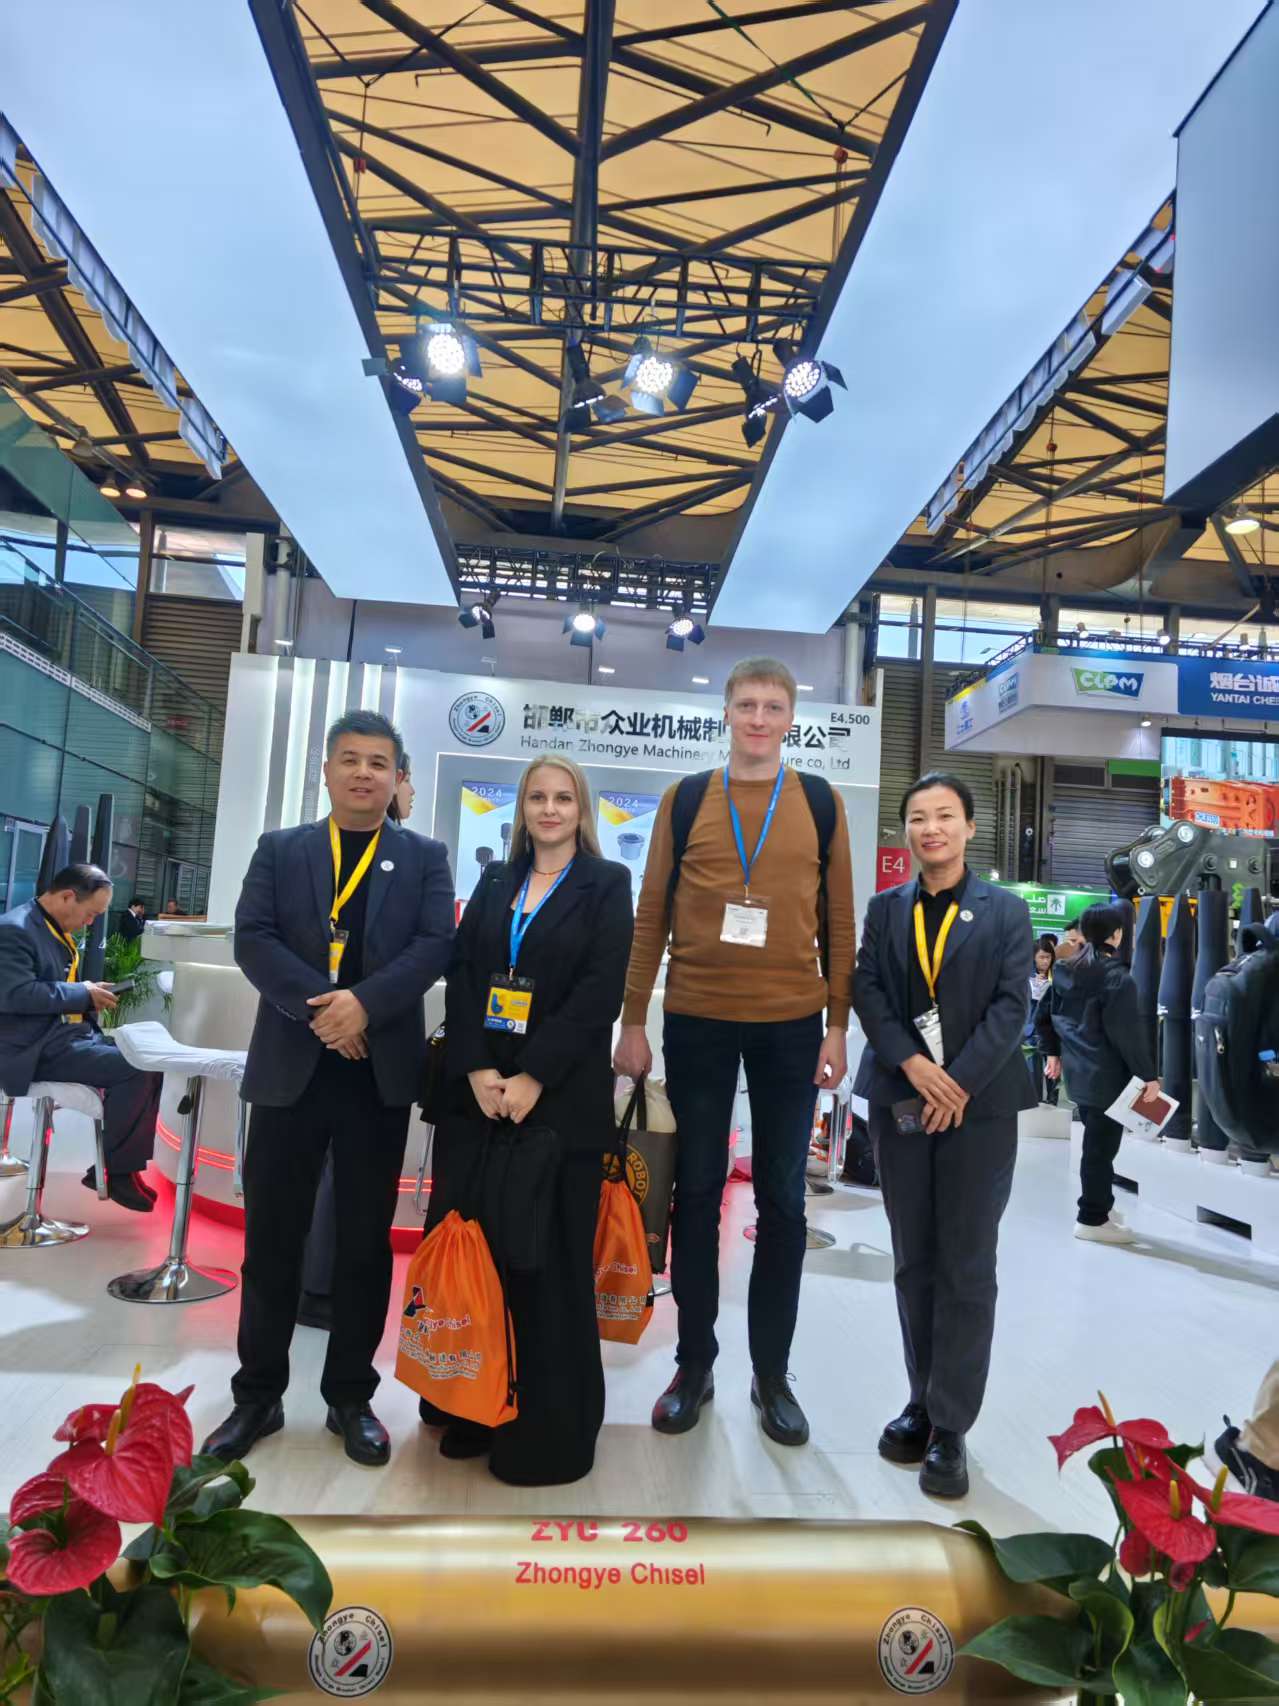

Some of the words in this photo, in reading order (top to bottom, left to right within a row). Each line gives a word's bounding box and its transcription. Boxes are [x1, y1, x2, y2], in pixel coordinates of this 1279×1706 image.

[1210, 692, 1250, 704] YANTAI
[522, 702, 851, 751] 邯郸市众业机械制限公司
[830, 712, 871, 725] E4.500
[520, 735, 573, 751] Handan
[578, 738, 639, 758] Zhongye
[471, 786, 503, 799] 2024
[608, 796, 639, 808] 2024
[882, 855, 905, 873] E4
[621, 1520, 689, 1542] 260
[515, 1561, 622, 1590] Zhongye
[630, 1562, 705, 1586] Chisel
[883, 1613, 912, 1645] Zhongye
